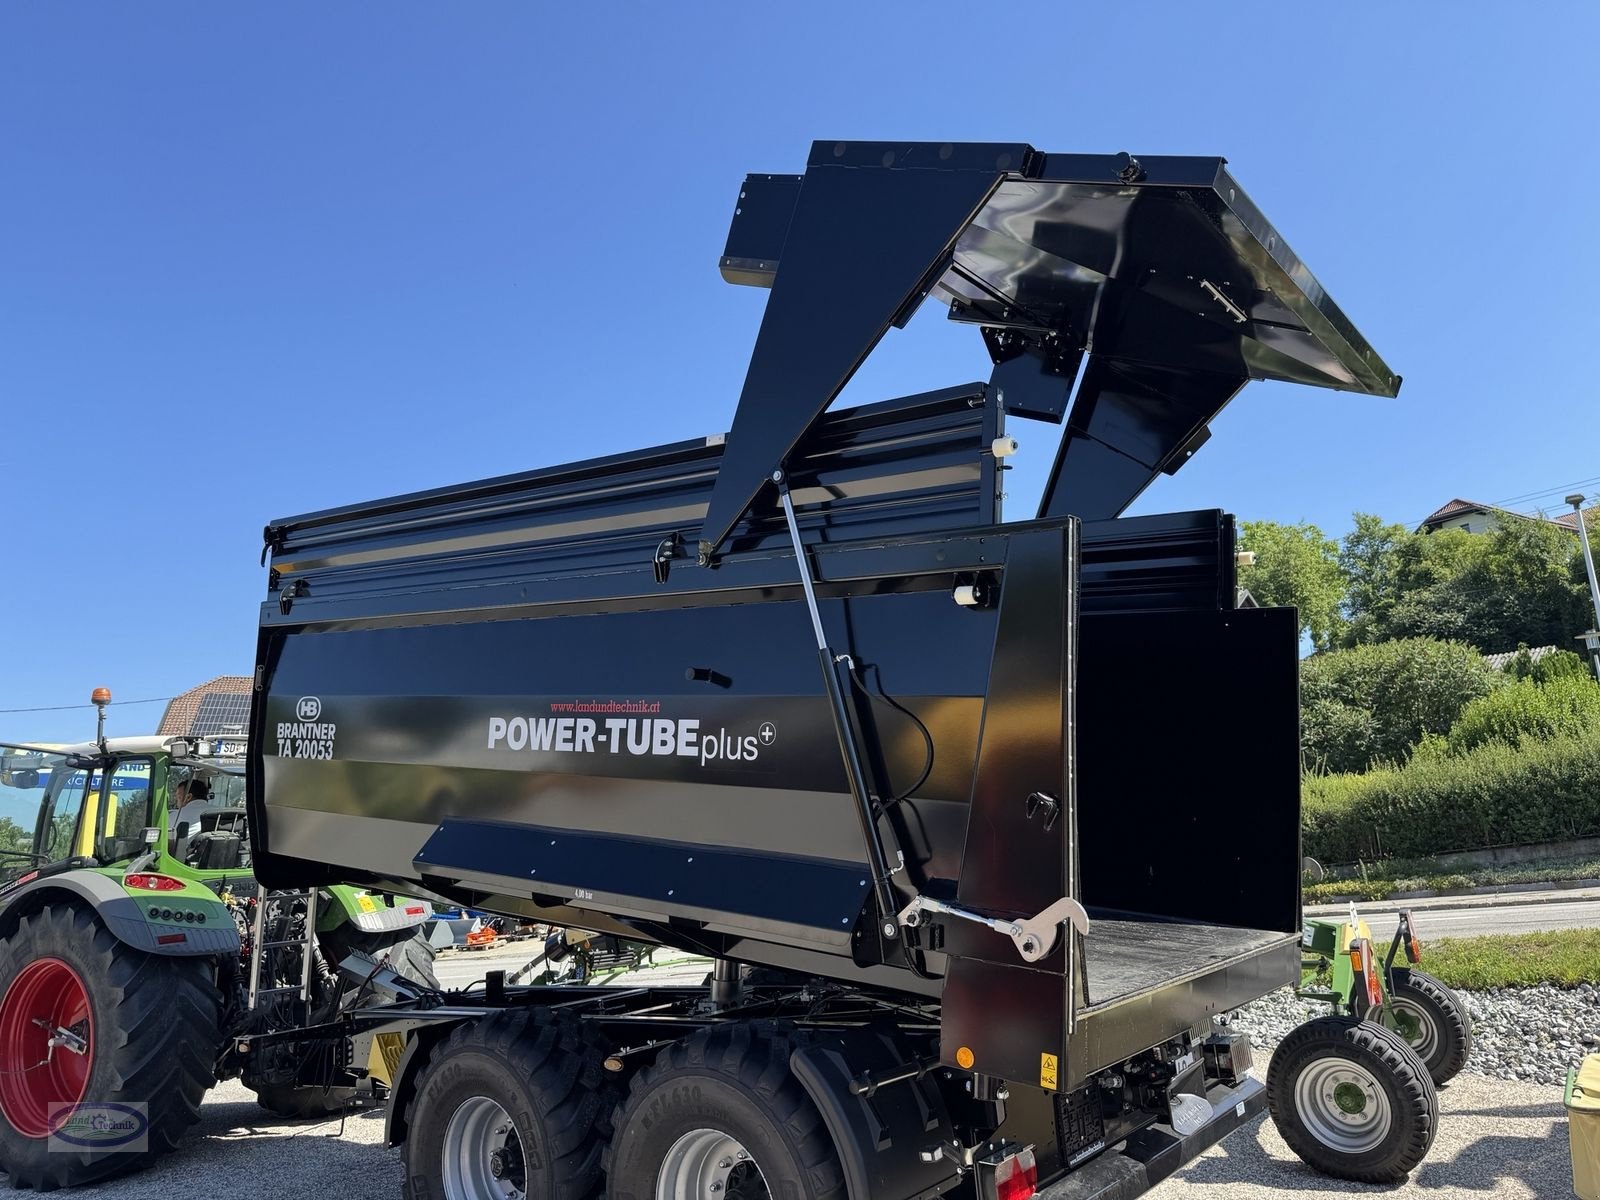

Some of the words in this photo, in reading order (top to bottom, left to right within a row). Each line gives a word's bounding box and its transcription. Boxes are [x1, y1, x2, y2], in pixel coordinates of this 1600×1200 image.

[550, 699, 661, 713] www.landundtechnik.at
[276, 722, 336, 740] BRANTNER
[277, 739, 292, 758] TA
[294, 739, 334, 761] 20053
[487, 716, 700, 757] POWER-TUBE
[701, 727, 759, 767] plus
